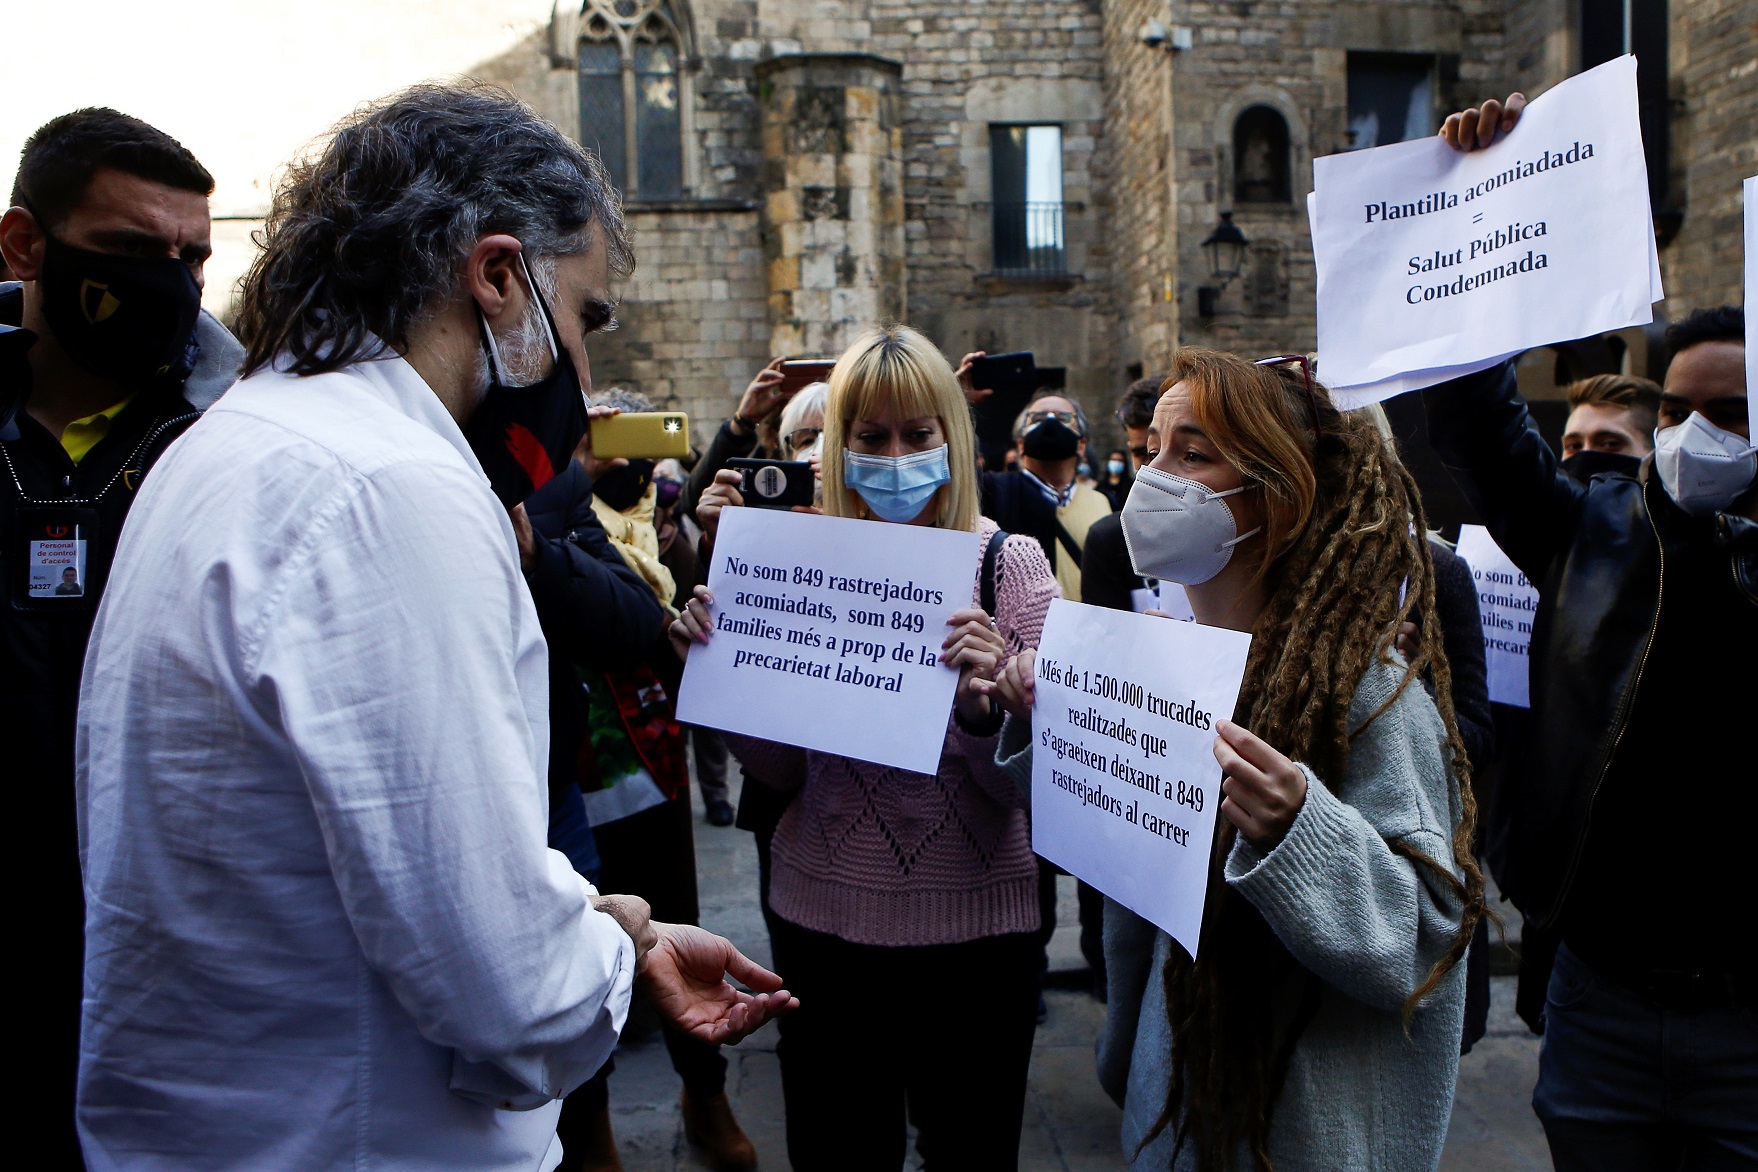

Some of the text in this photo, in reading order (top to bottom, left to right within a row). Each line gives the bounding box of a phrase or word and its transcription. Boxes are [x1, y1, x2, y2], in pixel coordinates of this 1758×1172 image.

[1364, 141, 1595, 223] Plantilla acomiadada
[1407, 220, 1548, 276] Salut Pública
[1406, 250, 1548, 305] Condemnada
[724, 556, 944, 605] No som 849 rastrejadors
[1485, 571, 1514, 586] som
[735, 590, 925, 633] acomiadats, som 849
[716, 612, 937, 668] families més a prop de la
[733, 649, 904, 693] precarietat laboral
[1038, 657, 1212, 731] Més de 1.500.000 trucades
[1068, 707, 1167, 759] realitzades que
[1042, 728, 1204, 812] s’agraeixen deixant a 849
[1052, 768, 1190, 848] rastrejadors al carrer
